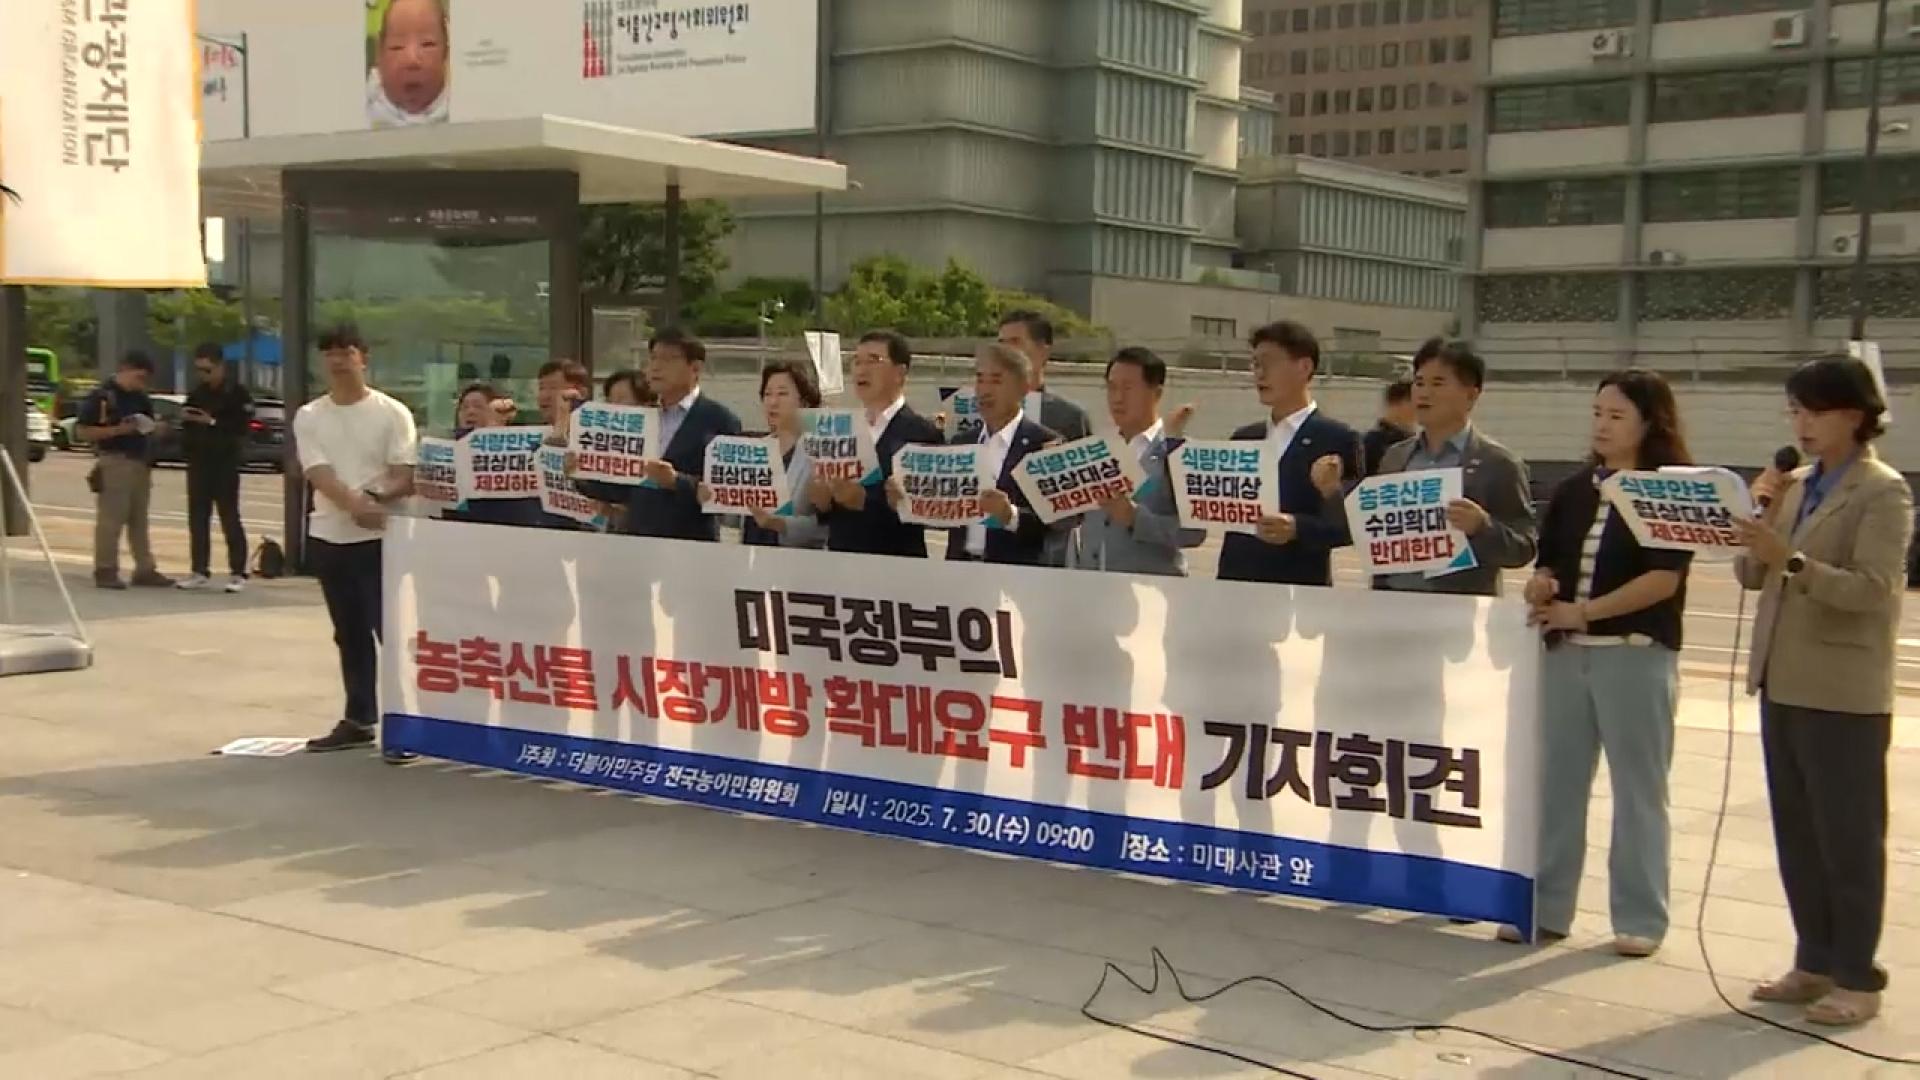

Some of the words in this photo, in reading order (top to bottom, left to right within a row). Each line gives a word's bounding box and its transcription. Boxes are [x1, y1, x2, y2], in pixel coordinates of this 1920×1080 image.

[579, 431, 645, 456] 수입확대
[1026, 440, 1111, 476] 식량안보
[1182, 447, 1260, 473] 식량안보
[711, 465, 772, 487] 협상대상
[903, 474, 979, 498] 협상대상
[1037, 458, 1121, 496] 협상대상
[1186, 473, 1263, 500] 협상대상
[1618, 476, 1721, 503] 식량안보
[714, 488, 778, 508] 제외하라
[1050, 476, 1134, 513] 제외하라
[1359, 478, 1443, 511] 농축산물
[1190, 500, 1263, 525] 제외하라
[1365, 506, 1447, 538] 수입확대
[1632, 499, 1732, 528] 협상대상
[1370, 533, 1455, 565] 반대한다
[734, 588, 1018, 679] 미국정부의
[415, 620, 600, 712] 농축산물
[611, 655, 813, 738] 시장개방
[824, 675, 1047, 768] 확대요구
[1062, 703, 1187, 790] 반대
[1200, 720, 1484, 829] 기자회견
[567, 750, 663, 785] 더불어민주당
[664, 764, 800, 807] 전국농어민위원회
[881, 799, 934, 827] 2025.
[942, 807, 959, 832] 7.
[1036, 821, 1096, 852] 09:00
[1192, 843, 1283, 880] 미대사관
[1289, 857, 1315, 887] 앞
